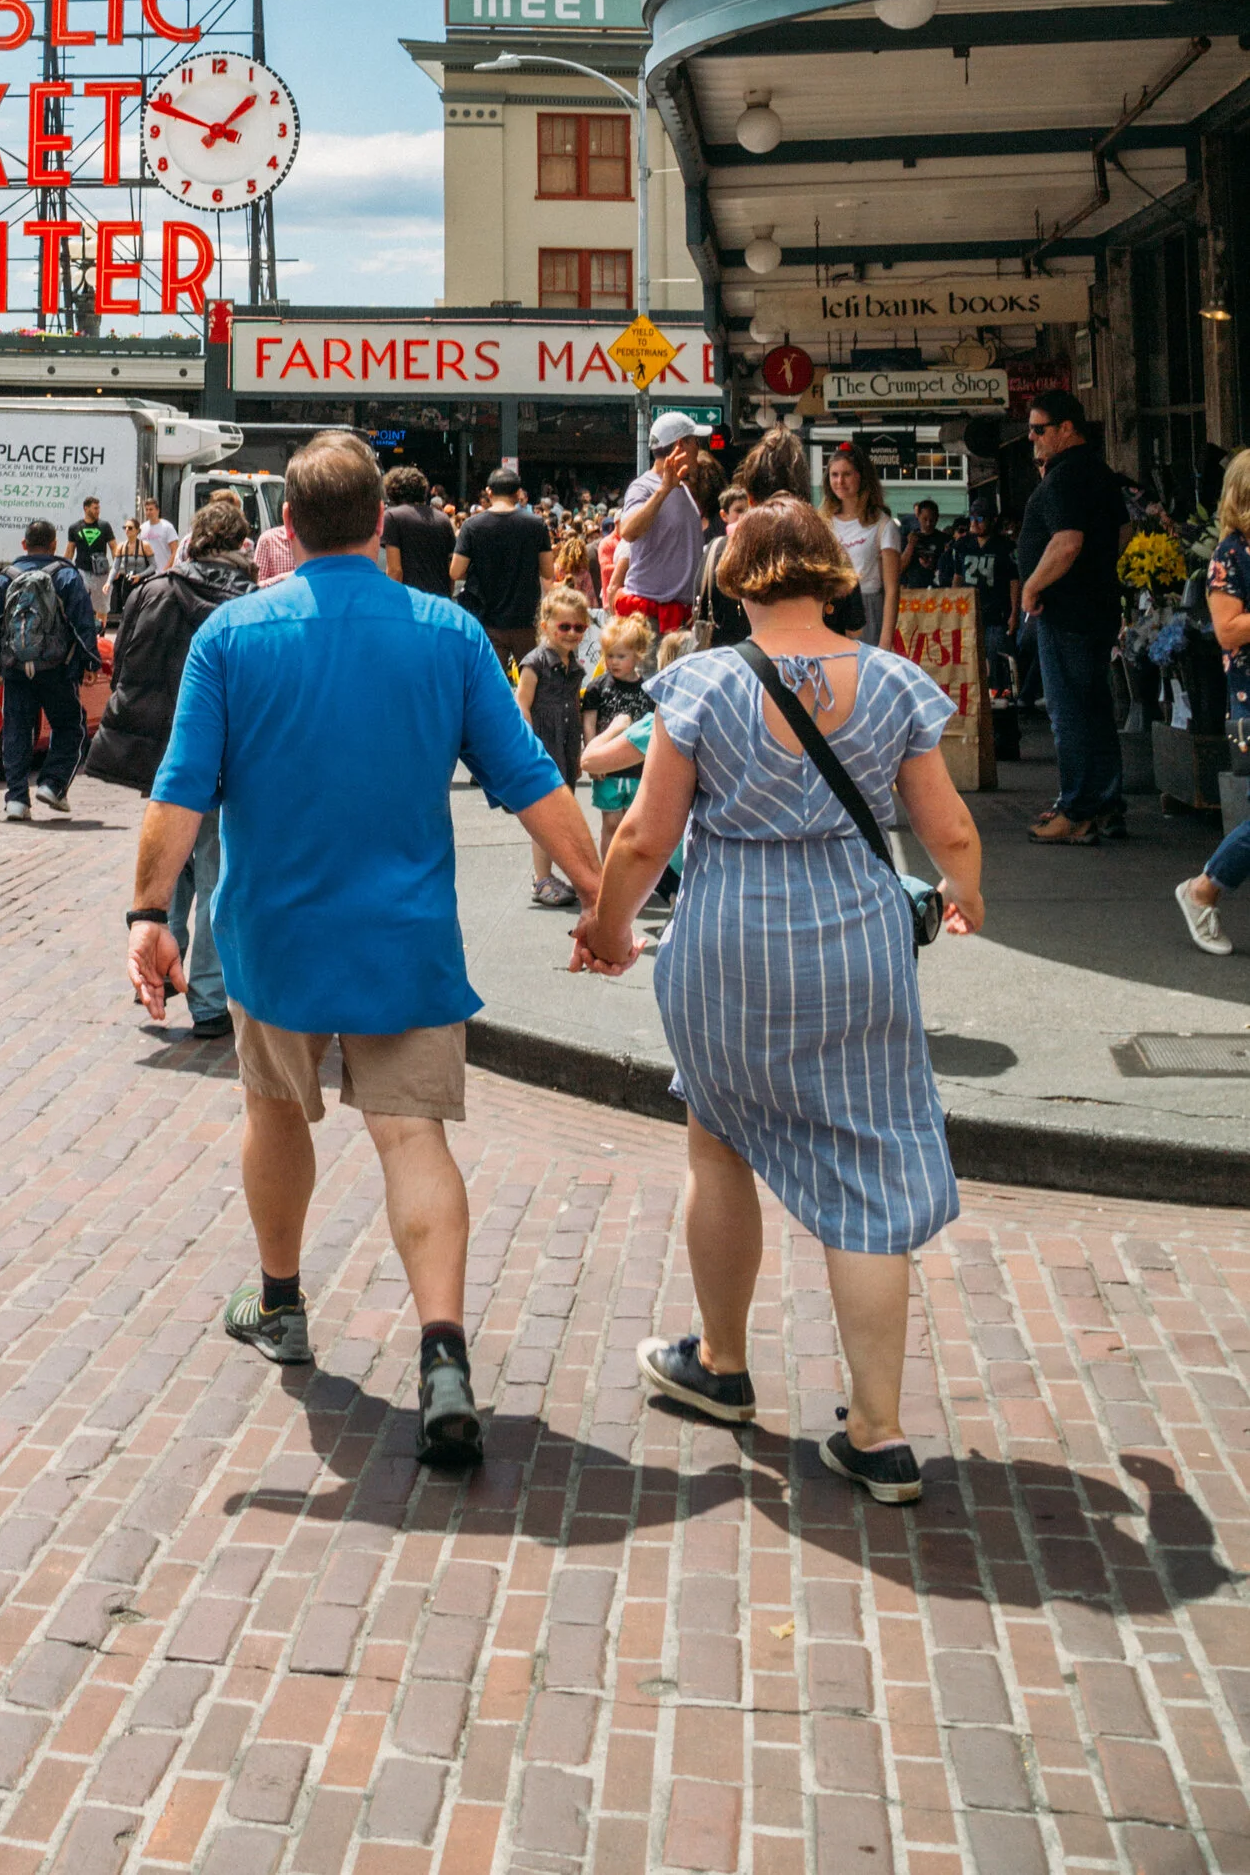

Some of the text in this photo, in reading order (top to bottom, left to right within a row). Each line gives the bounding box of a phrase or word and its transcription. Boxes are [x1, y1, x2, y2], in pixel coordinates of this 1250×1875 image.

[212, 58, 228, 74] 12
[249, 66, 254, 82] 1
[182, 68, 193, 84] 11
[270, 90, 280, 106] 2
[150, 125, 161, 139] 9
[278, 122, 287, 138] 3
[157, 157, 168, 171] 8
[266, 155, 279, 170] 4
[181, 180, 192, 195] 7
[246, 179, 257, 194] 5
[212, 188, 223, 203] 6
[866, 294, 938, 318] bank
[949, 291, 1040, 315] books
[631, 328, 654, 336] YIELD
[638, 338, 647, 346] TO
[256, 337, 500, 382] FARMERS
[616, 348, 668, 357] PEDESTRIANS
[831, 375, 866, 397] The
[869, 374, 946, 399] Crumpet
[951, 372, 1000, 398] Shop
[62, 446, 105, 465] FISH
[964, 555, 995, 586] 24
